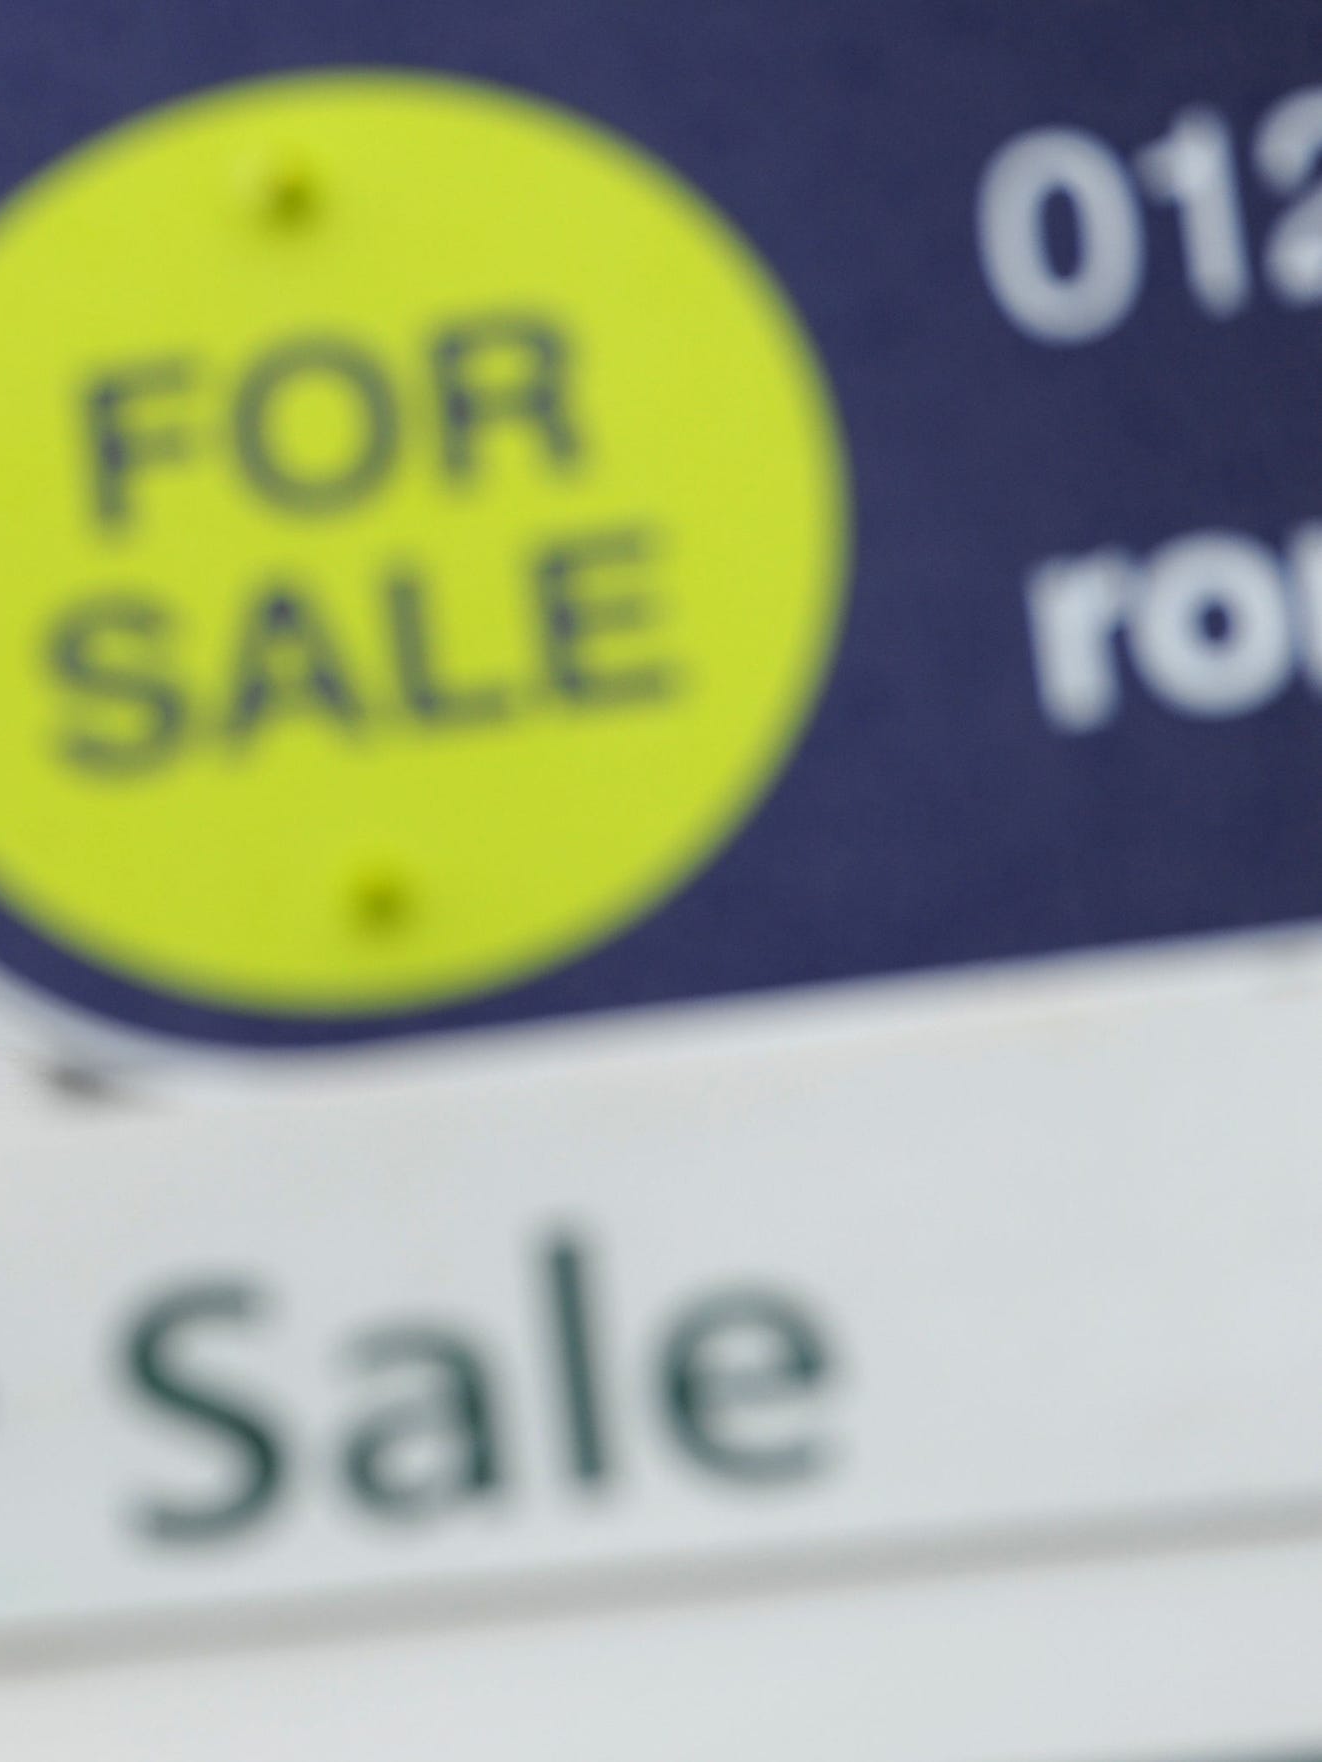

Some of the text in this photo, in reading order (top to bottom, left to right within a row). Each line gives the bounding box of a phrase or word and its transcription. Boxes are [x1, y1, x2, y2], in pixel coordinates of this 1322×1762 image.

[78, 310, 590, 530] FOR
[40, 522, 686, 778] SALE
[1026, 520, 1322, 732] ro
[116, 1220, 836, 1550] Sale
